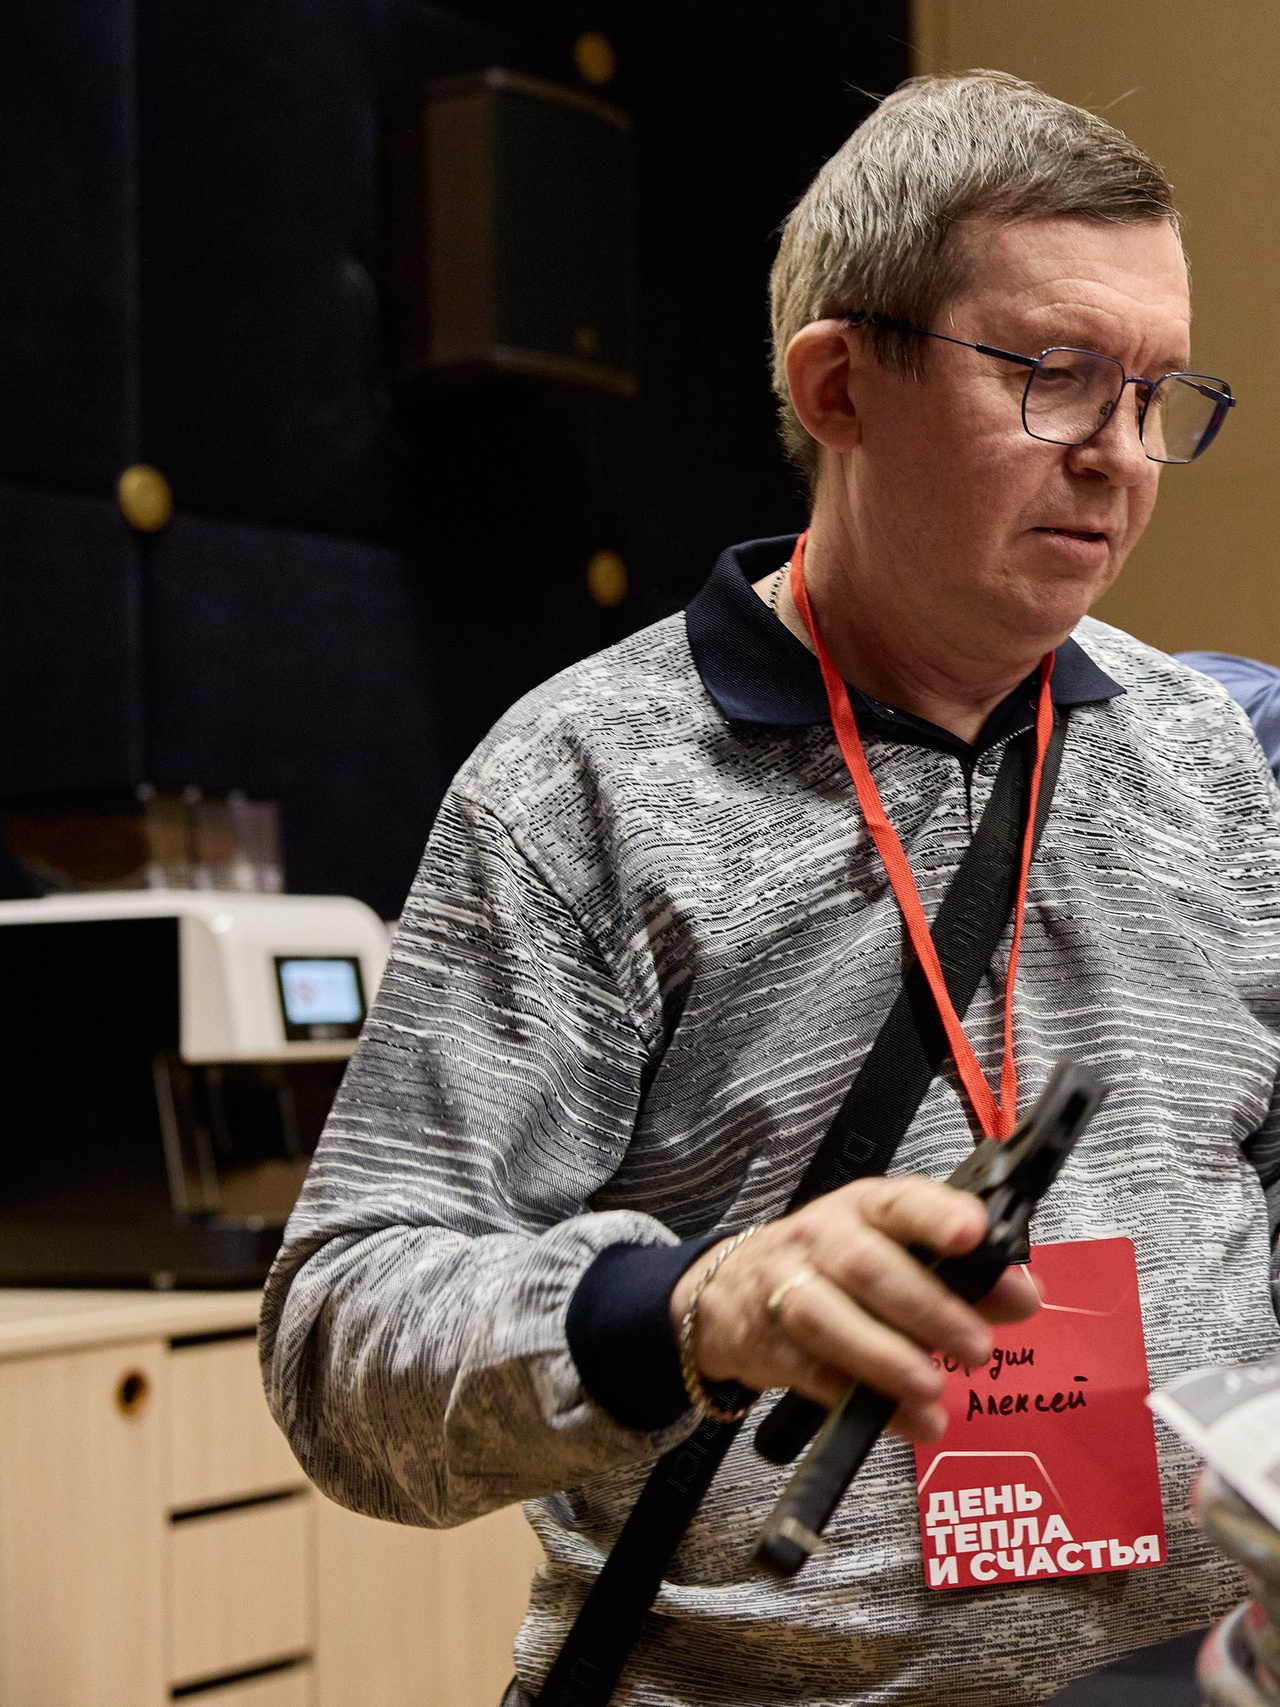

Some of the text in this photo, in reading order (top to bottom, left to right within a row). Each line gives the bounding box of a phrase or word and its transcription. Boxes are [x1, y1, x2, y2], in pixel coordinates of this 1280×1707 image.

[966, 1375, 1089, 1421] Алексей
[925, 1483, 1043, 1526] ДЕНЬ
[927, 1514, 1074, 1556] ТЕПЛА
[928, 1534, 1162, 1586] И СЧАСТЬЯ
